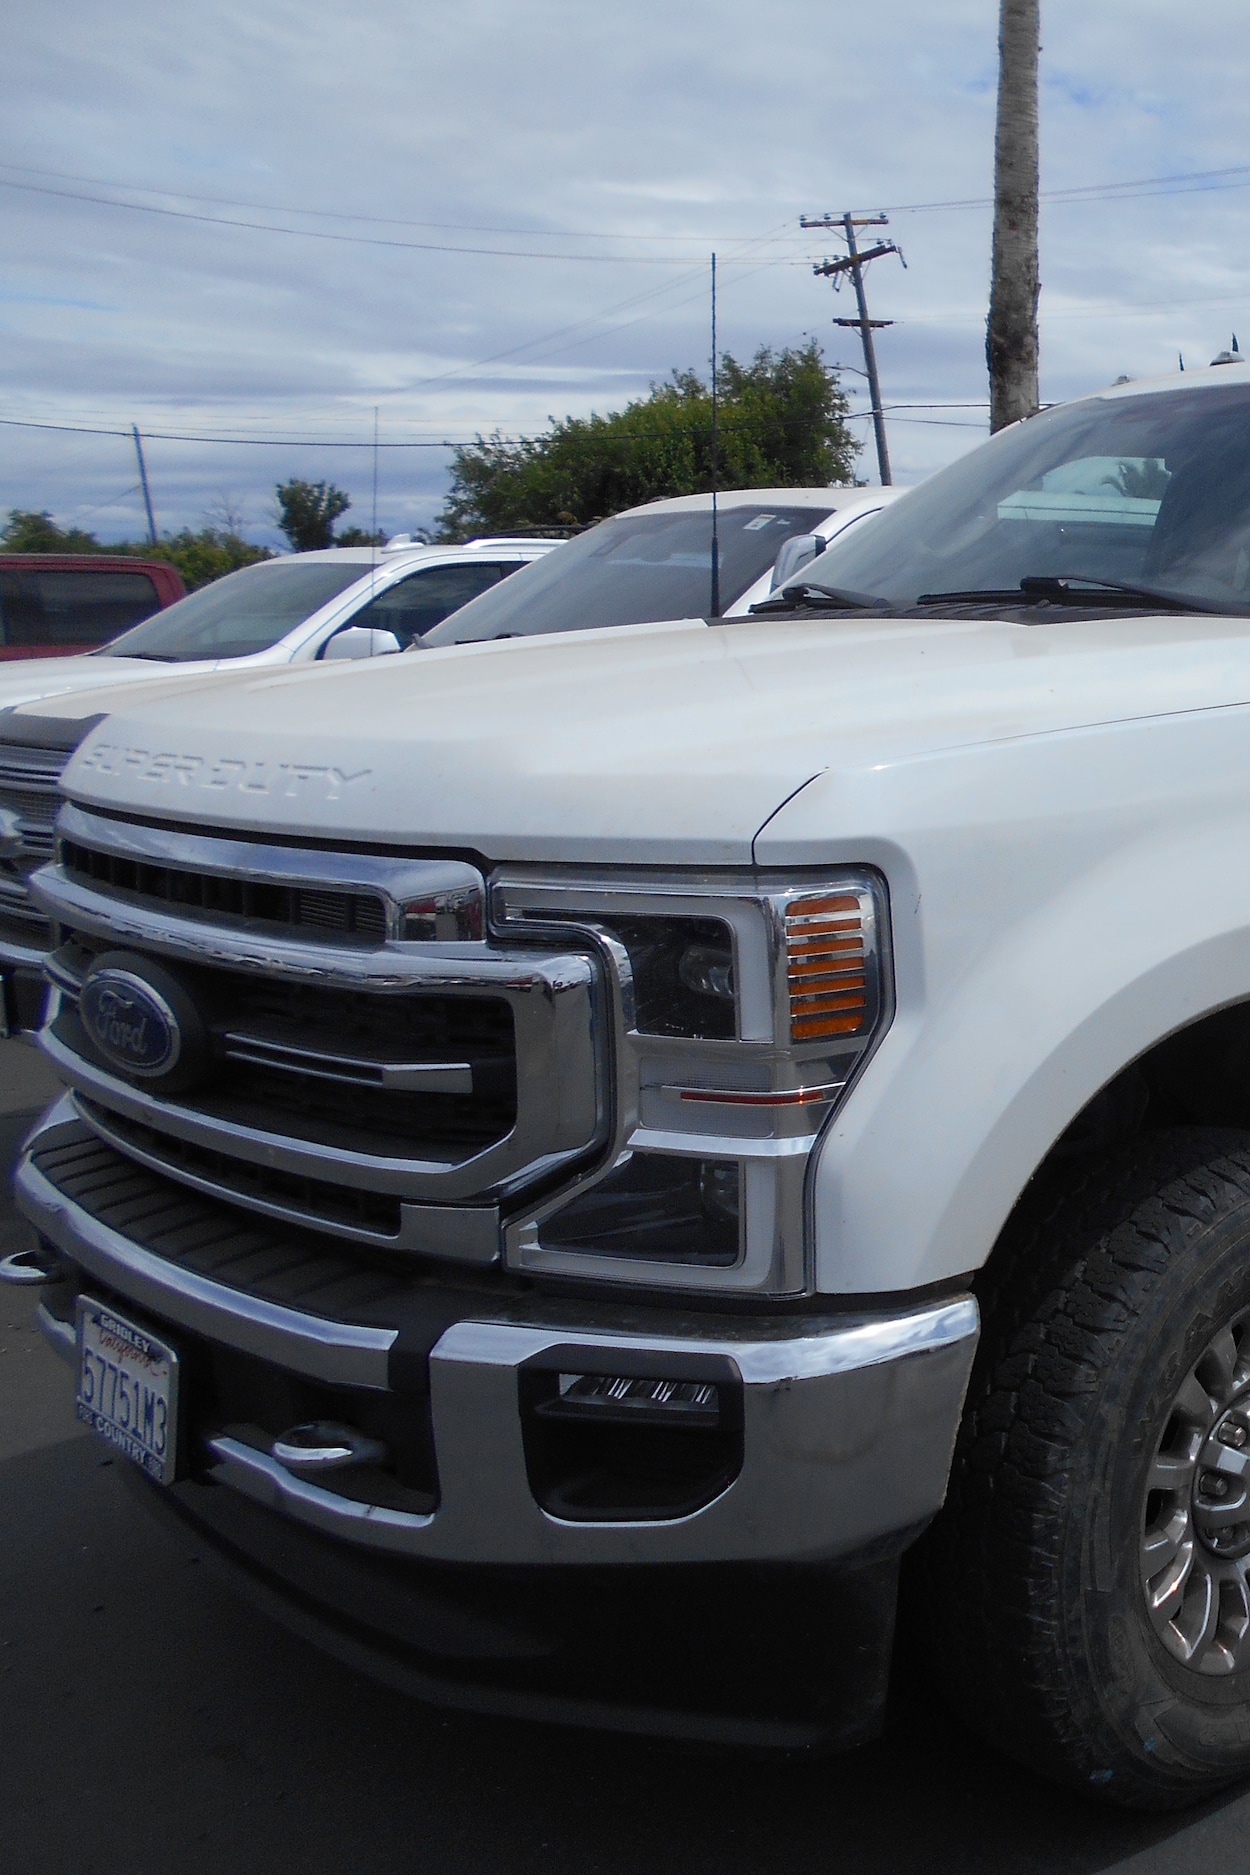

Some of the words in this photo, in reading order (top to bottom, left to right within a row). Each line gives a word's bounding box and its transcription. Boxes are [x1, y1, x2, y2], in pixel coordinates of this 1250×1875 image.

[80, 744, 204, 786] SUPER
[200, 758, 373, 800] DUTY
[96, 989, 147, 1057] Ford
[100, 1313, 150, 1353] GRIDLEY
[84, 1347, 168, 1456] 57751M3
[96, 1416, 146, 1464] COUNTRY
